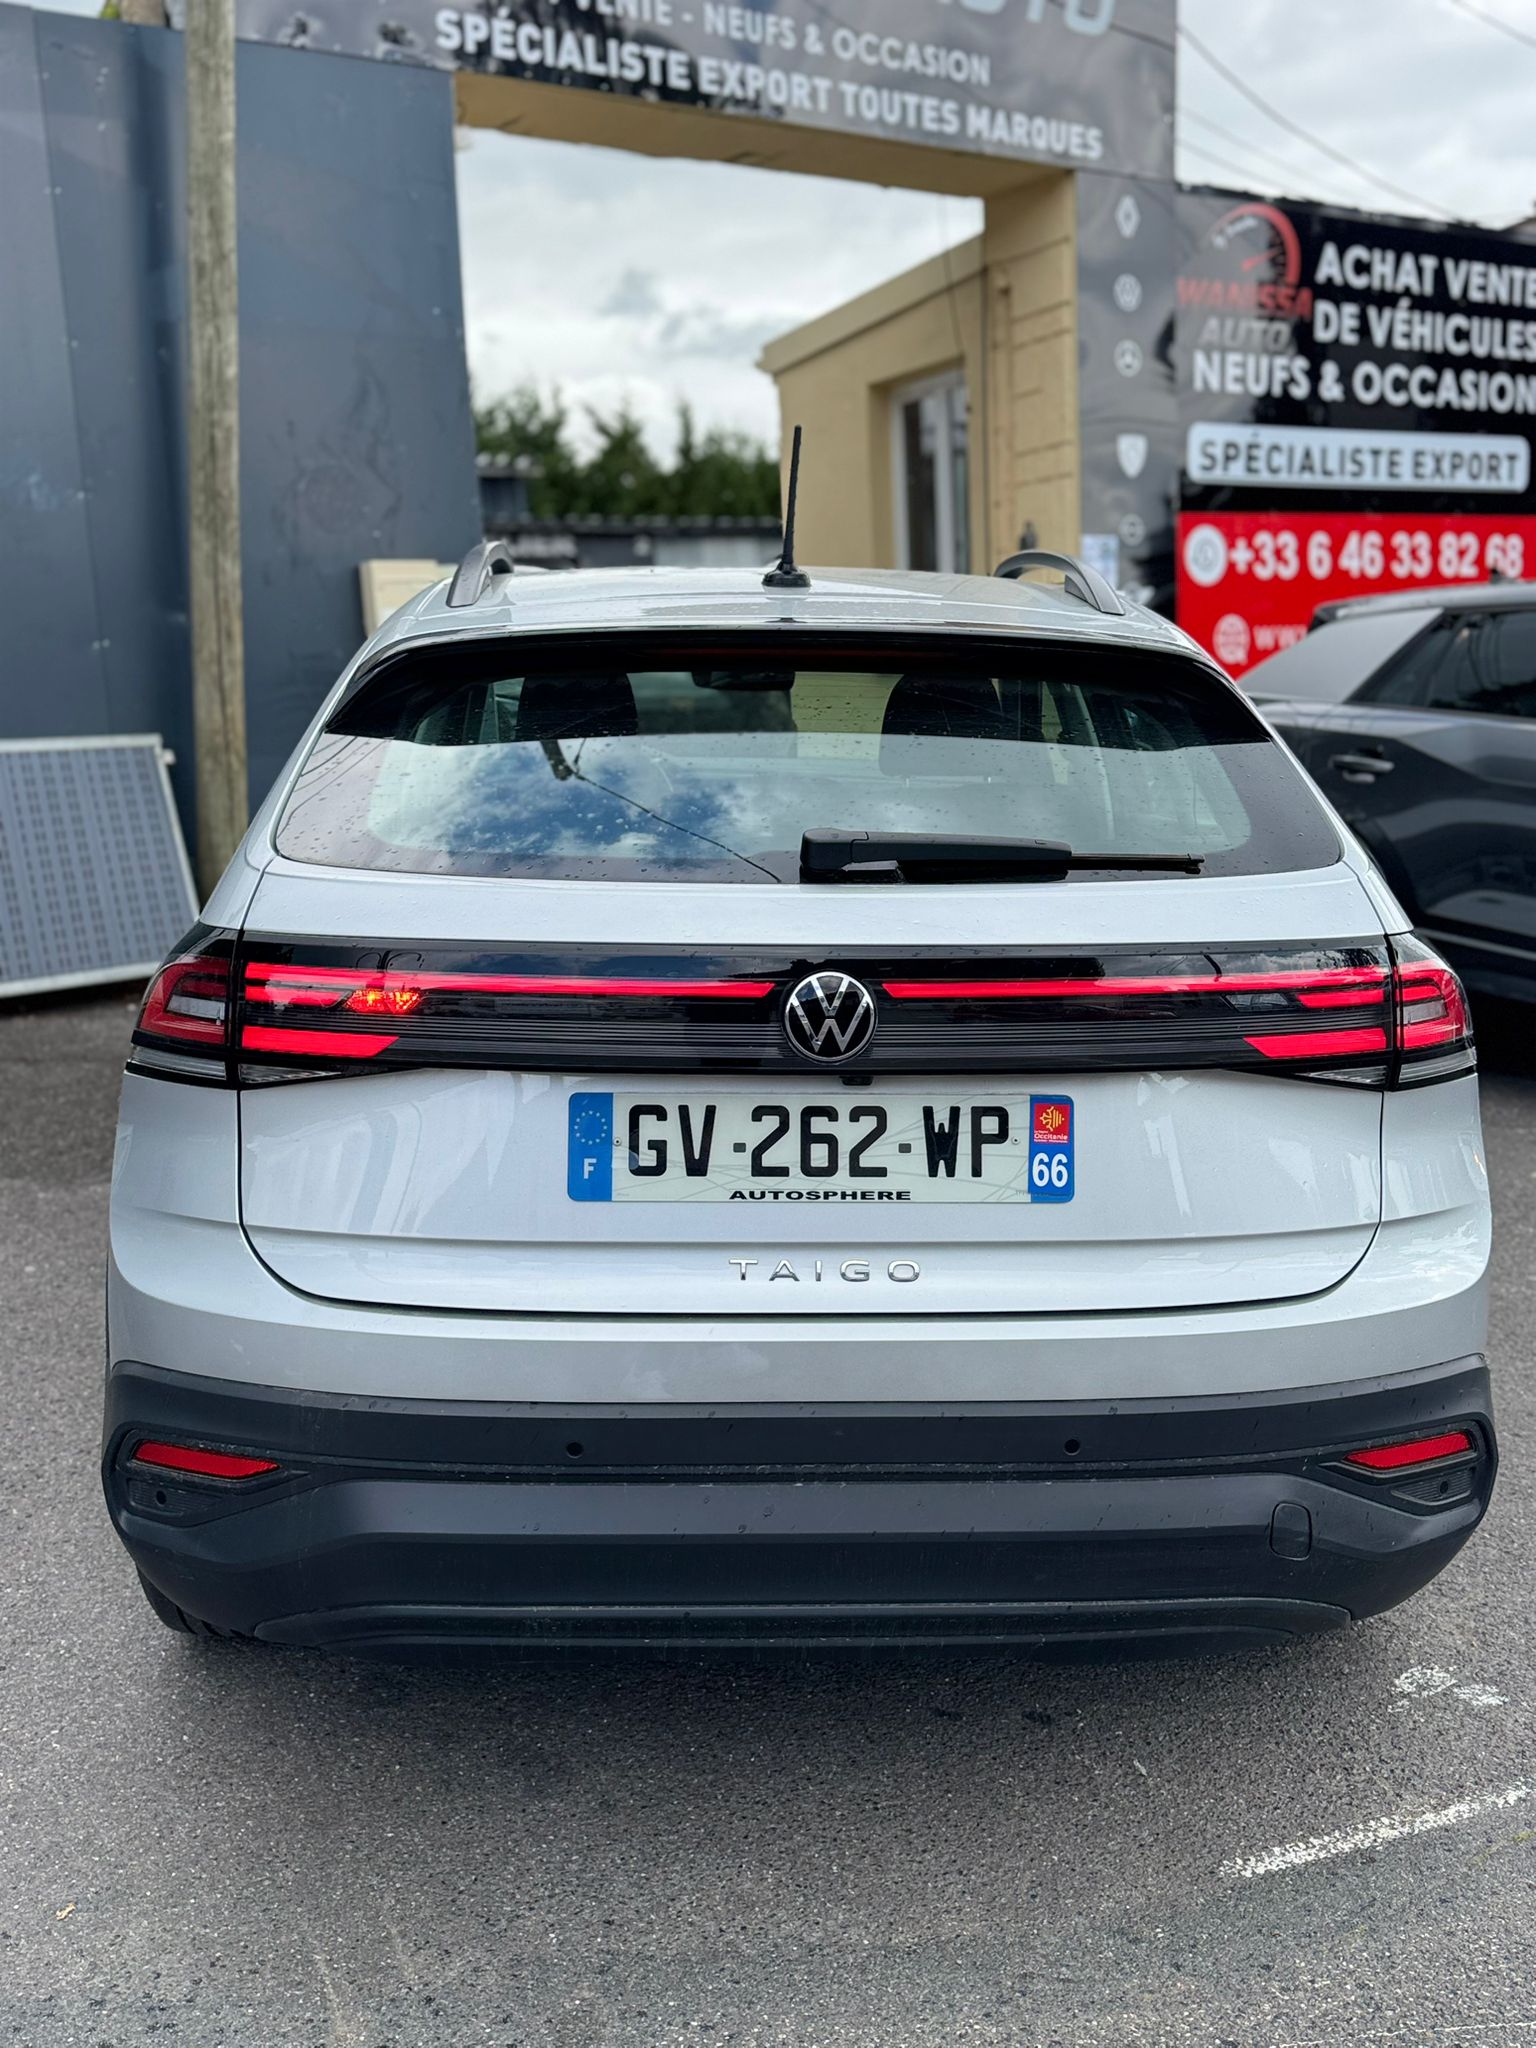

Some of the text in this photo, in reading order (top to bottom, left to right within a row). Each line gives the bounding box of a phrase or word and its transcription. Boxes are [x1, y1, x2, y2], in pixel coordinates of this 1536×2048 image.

[703, 3, 798, 51] NEUFS
[804, 25, 825, 57] &
[832, 28, 991, 87] OCCASION
[435, 6, 1104, 160] SPÉCIALISTE EXPORT TOUTES MARQUES
[1314, 240, 1440, 297] ACHAT
[1200, 315, 1293, 353] AUTO
[1313, 298, 1362, 347] DE
[1192, 349, 1312, 400] NEUFS
[1318, 359, 1345, 402] &
[1201, 431, 1520, 483] SPÉCIALISTE EXPORT
[1230, 530, 1525, 581] +33 6 46 33 82 68
[583, 1157, 598, 1181] F
[1032, 1152, 1069, 1188] 66
[728, 1190, 912, 1202] AUTOSPHERE
[728, 1258, 922, 1283] TAIGO
